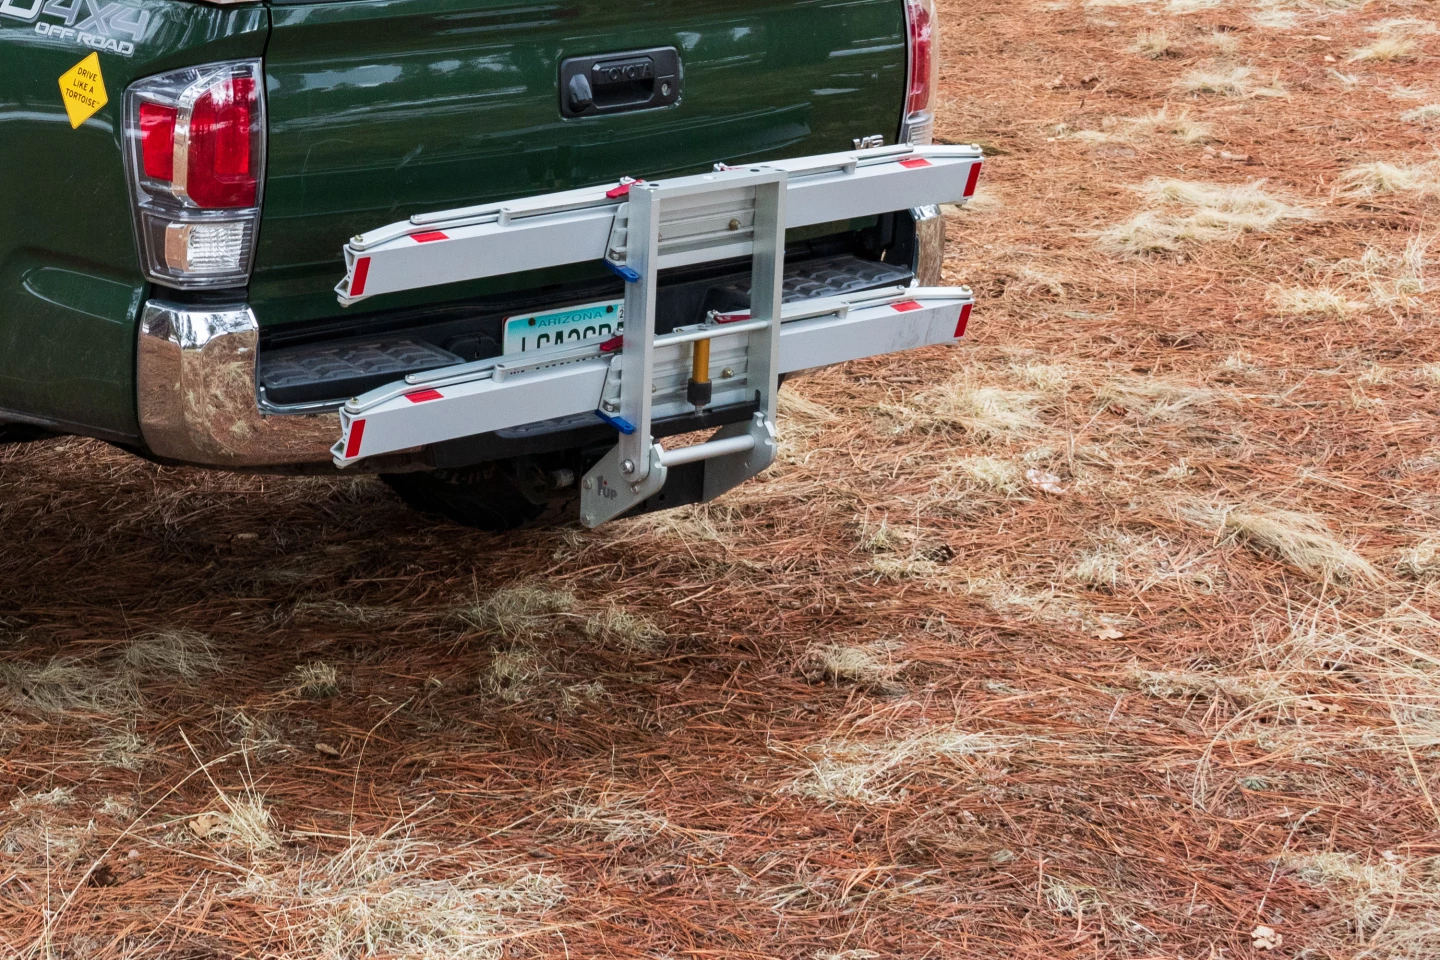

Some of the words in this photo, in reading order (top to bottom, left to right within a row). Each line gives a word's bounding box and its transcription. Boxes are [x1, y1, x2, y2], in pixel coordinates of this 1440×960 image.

[34, 21, 76, 39] OFF
[76, 31, 135, 57] ROAD
[77, 67, 98, 82] DRIVE
[601, 63, 650, 81] TOYOTA
[73, 78, 89, 92] LIKE
[88, 86, 94, 95] A
[852, 134, 884, 150] V6
[538, 311, 603, 328] ARIZONA
